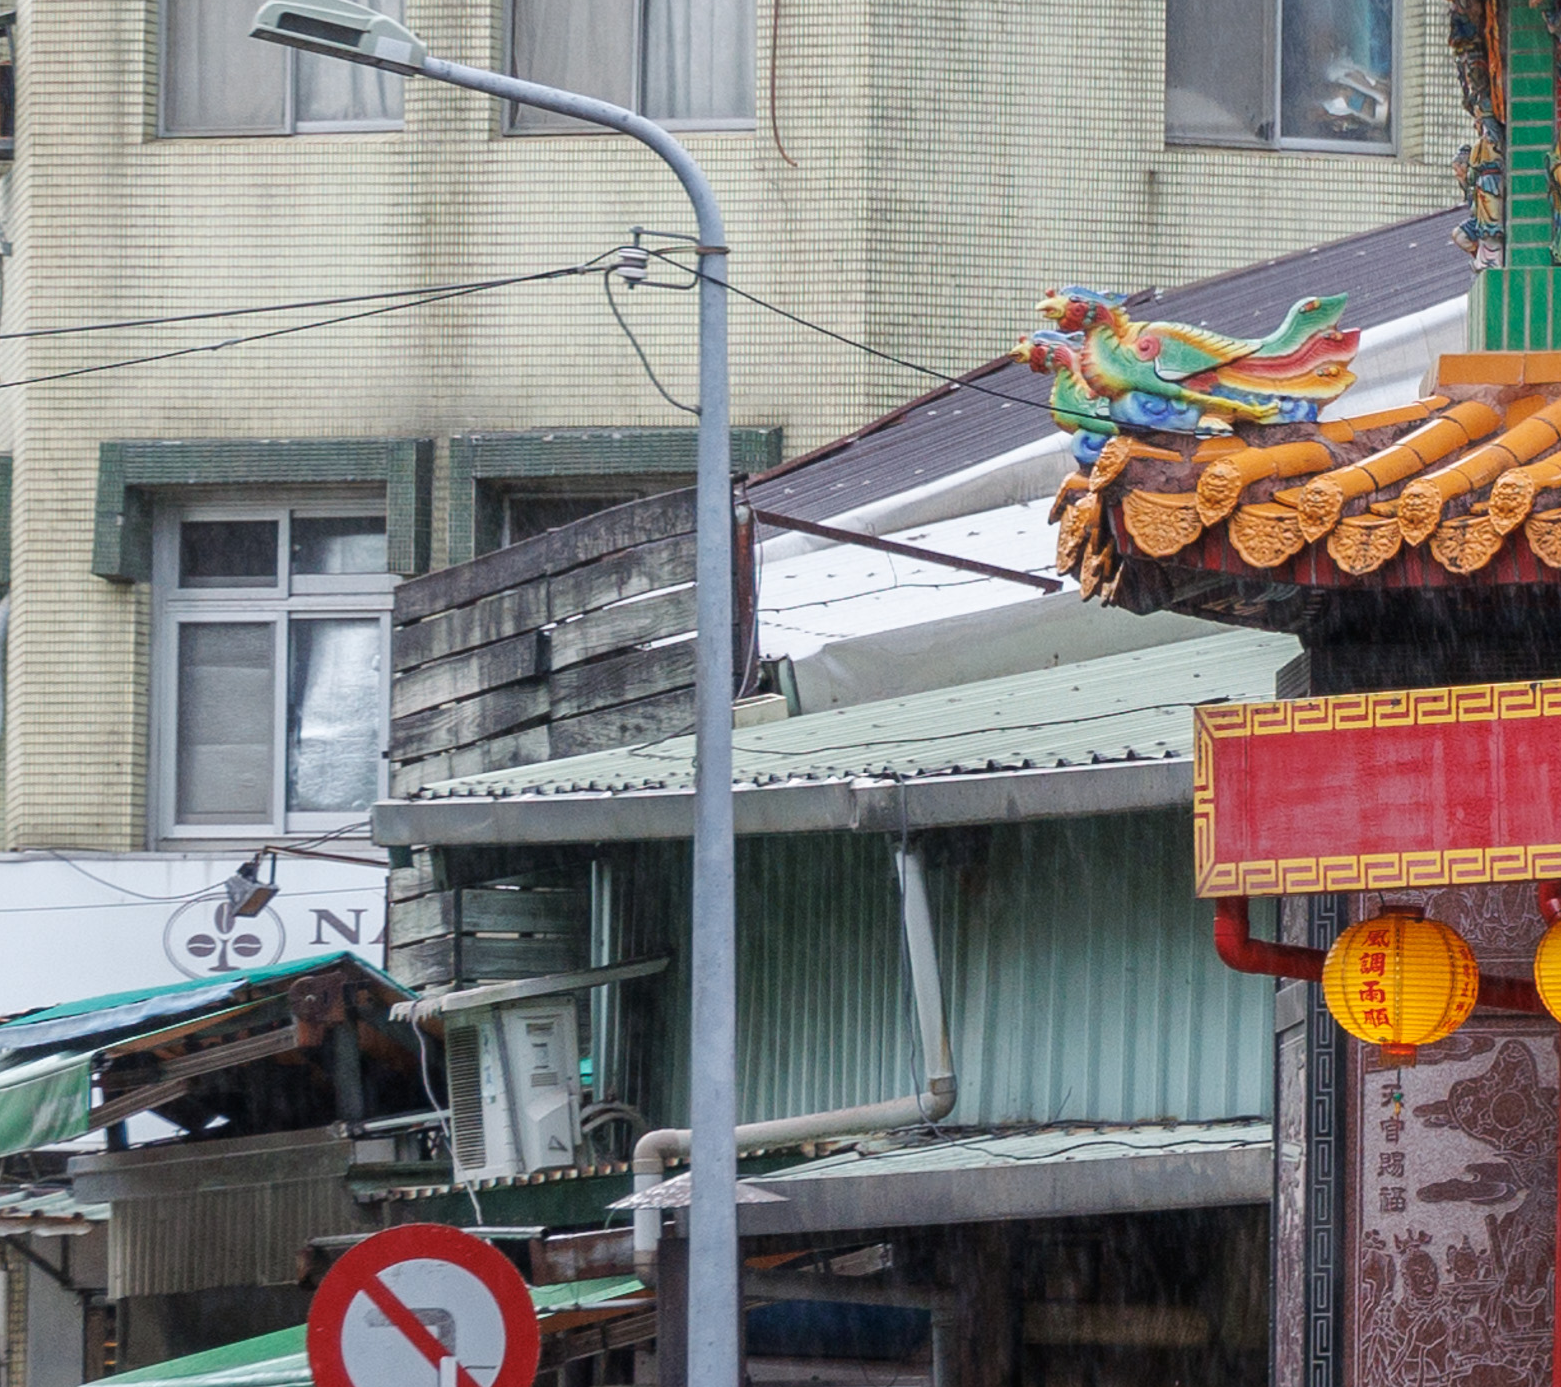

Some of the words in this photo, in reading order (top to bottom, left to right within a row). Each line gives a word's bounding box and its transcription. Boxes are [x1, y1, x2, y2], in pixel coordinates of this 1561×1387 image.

[1359, 928, 1394, 1029] 風調雨順
[1376, 1083, 1407, 1215] 天官賜福
